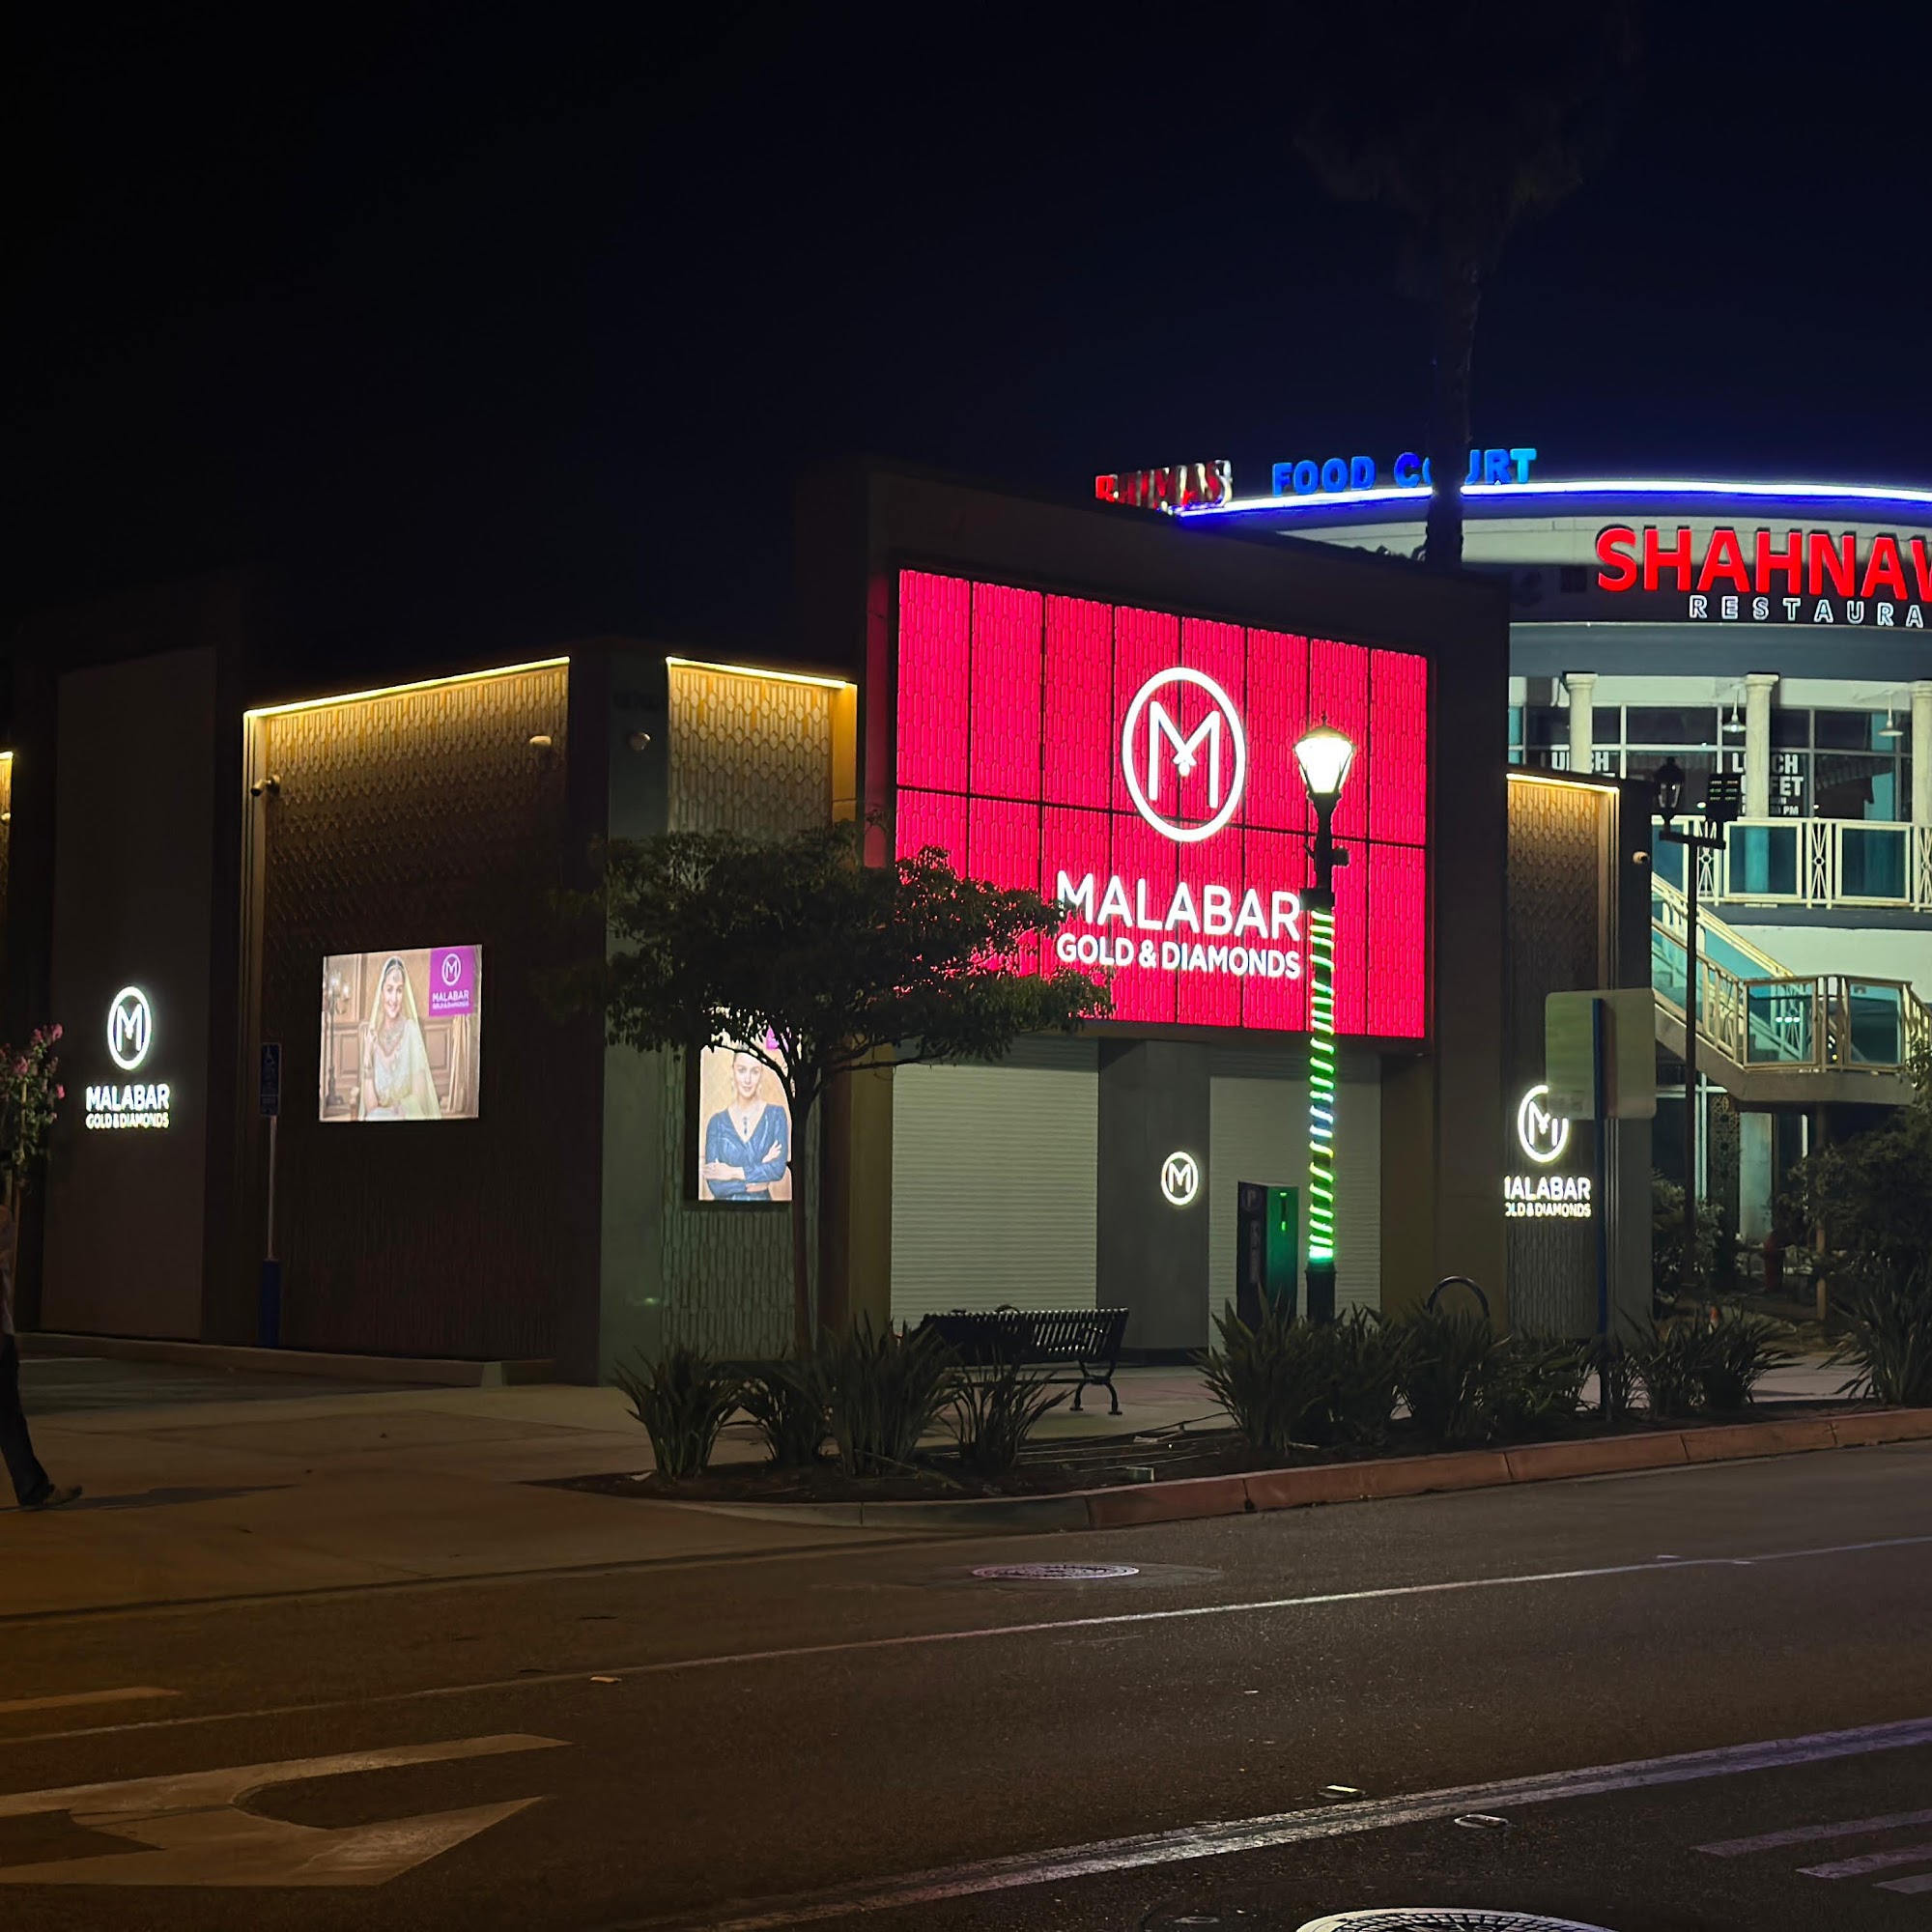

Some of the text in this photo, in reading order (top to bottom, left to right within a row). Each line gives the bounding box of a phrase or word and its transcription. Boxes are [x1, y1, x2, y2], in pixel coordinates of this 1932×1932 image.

[1272, 456, 1377, 497] FOOD
[1689, 594, 1924, 628] RESTAURA
[1732, 753, 1799, 774] LCH
[1057, 869, 1301, 941] MALABAR
[1057, 932, 1301, 980] GOLD & DIAMONDS
[432, 989, 469, 1003] MALABAR
[85, 1083, 171, 1112] MALABAR
[85, 1112, 112, 1129] GOLD
[120, 1112, 170, 1129] DIAMONDS
[1535, 1203, 1592, 1217] DIAMONDS
